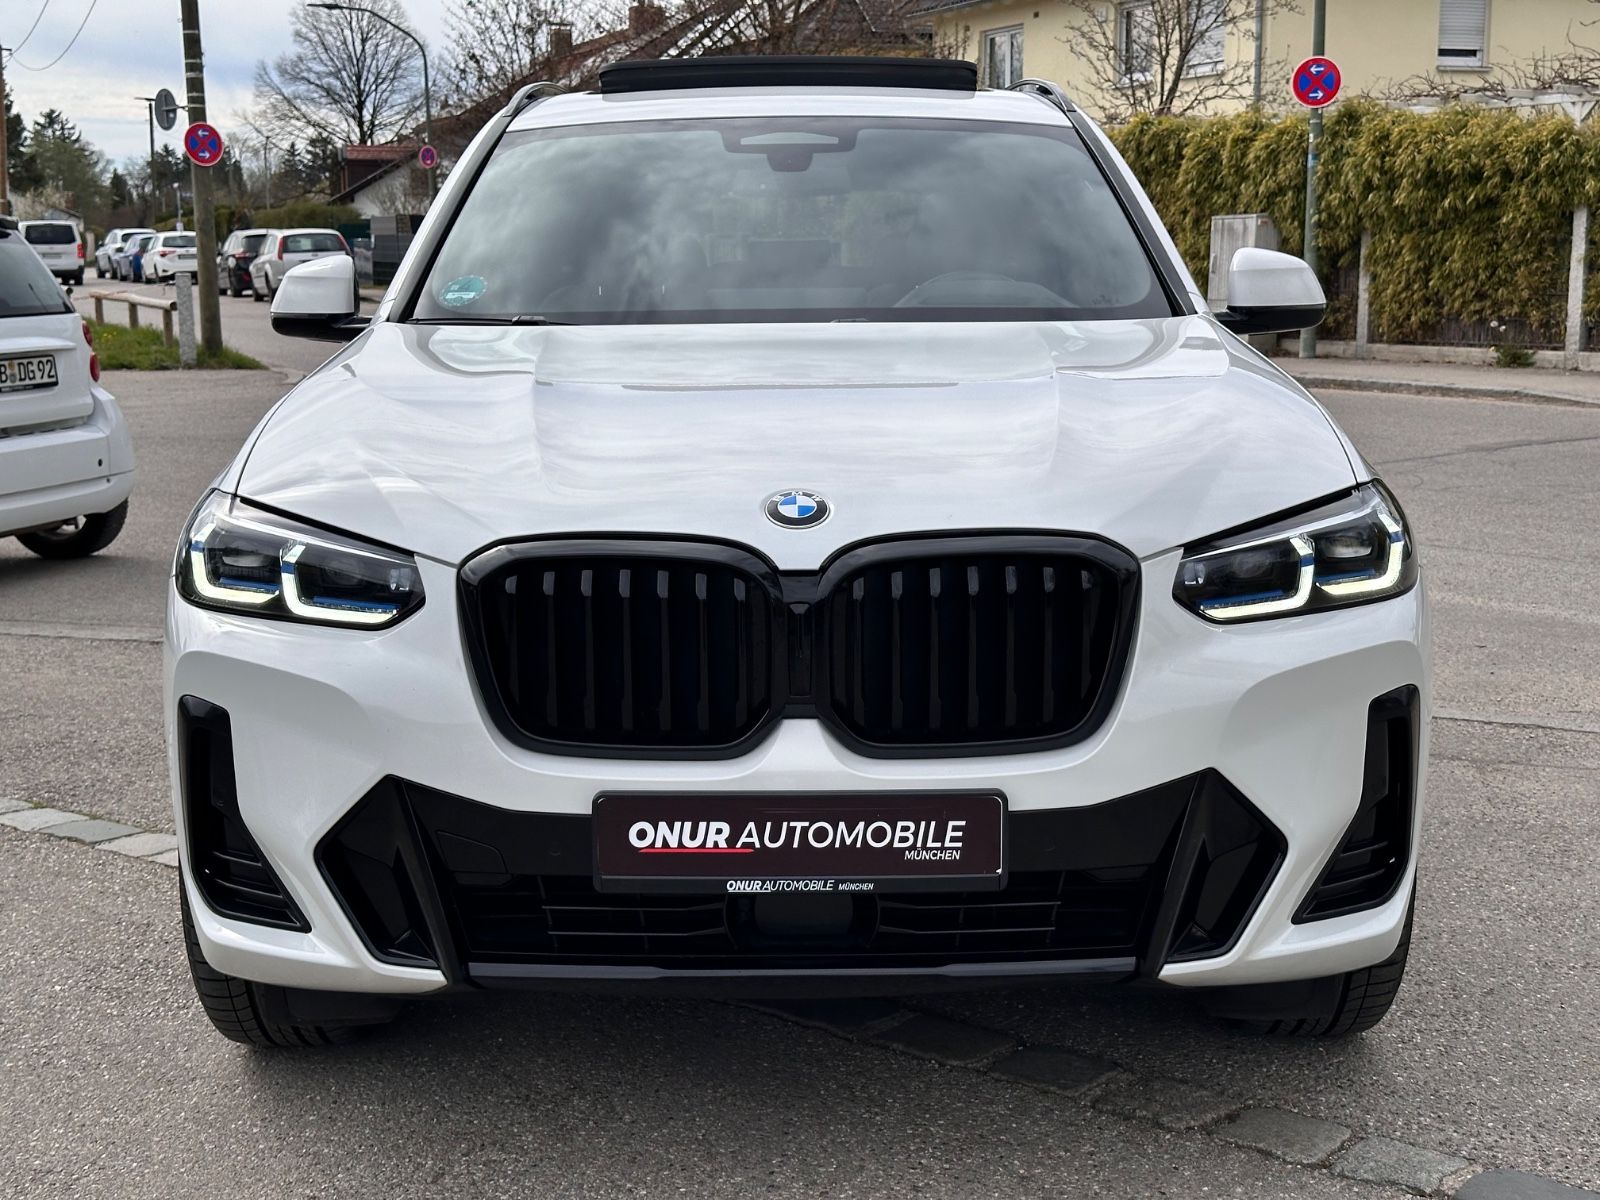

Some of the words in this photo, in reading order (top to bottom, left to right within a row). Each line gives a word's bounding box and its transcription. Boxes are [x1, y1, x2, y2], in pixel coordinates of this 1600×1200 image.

[17, 361, 36, 382] DG
[37, 359, 55, 379] 92
[628, 821, 730, 848] ONUR
[735, 820, 966, 848] AUTOMOBILE
[904, 847, 961, 860] MÜNCHEN
[838, 882, 875, 891] MÜNCHEN
